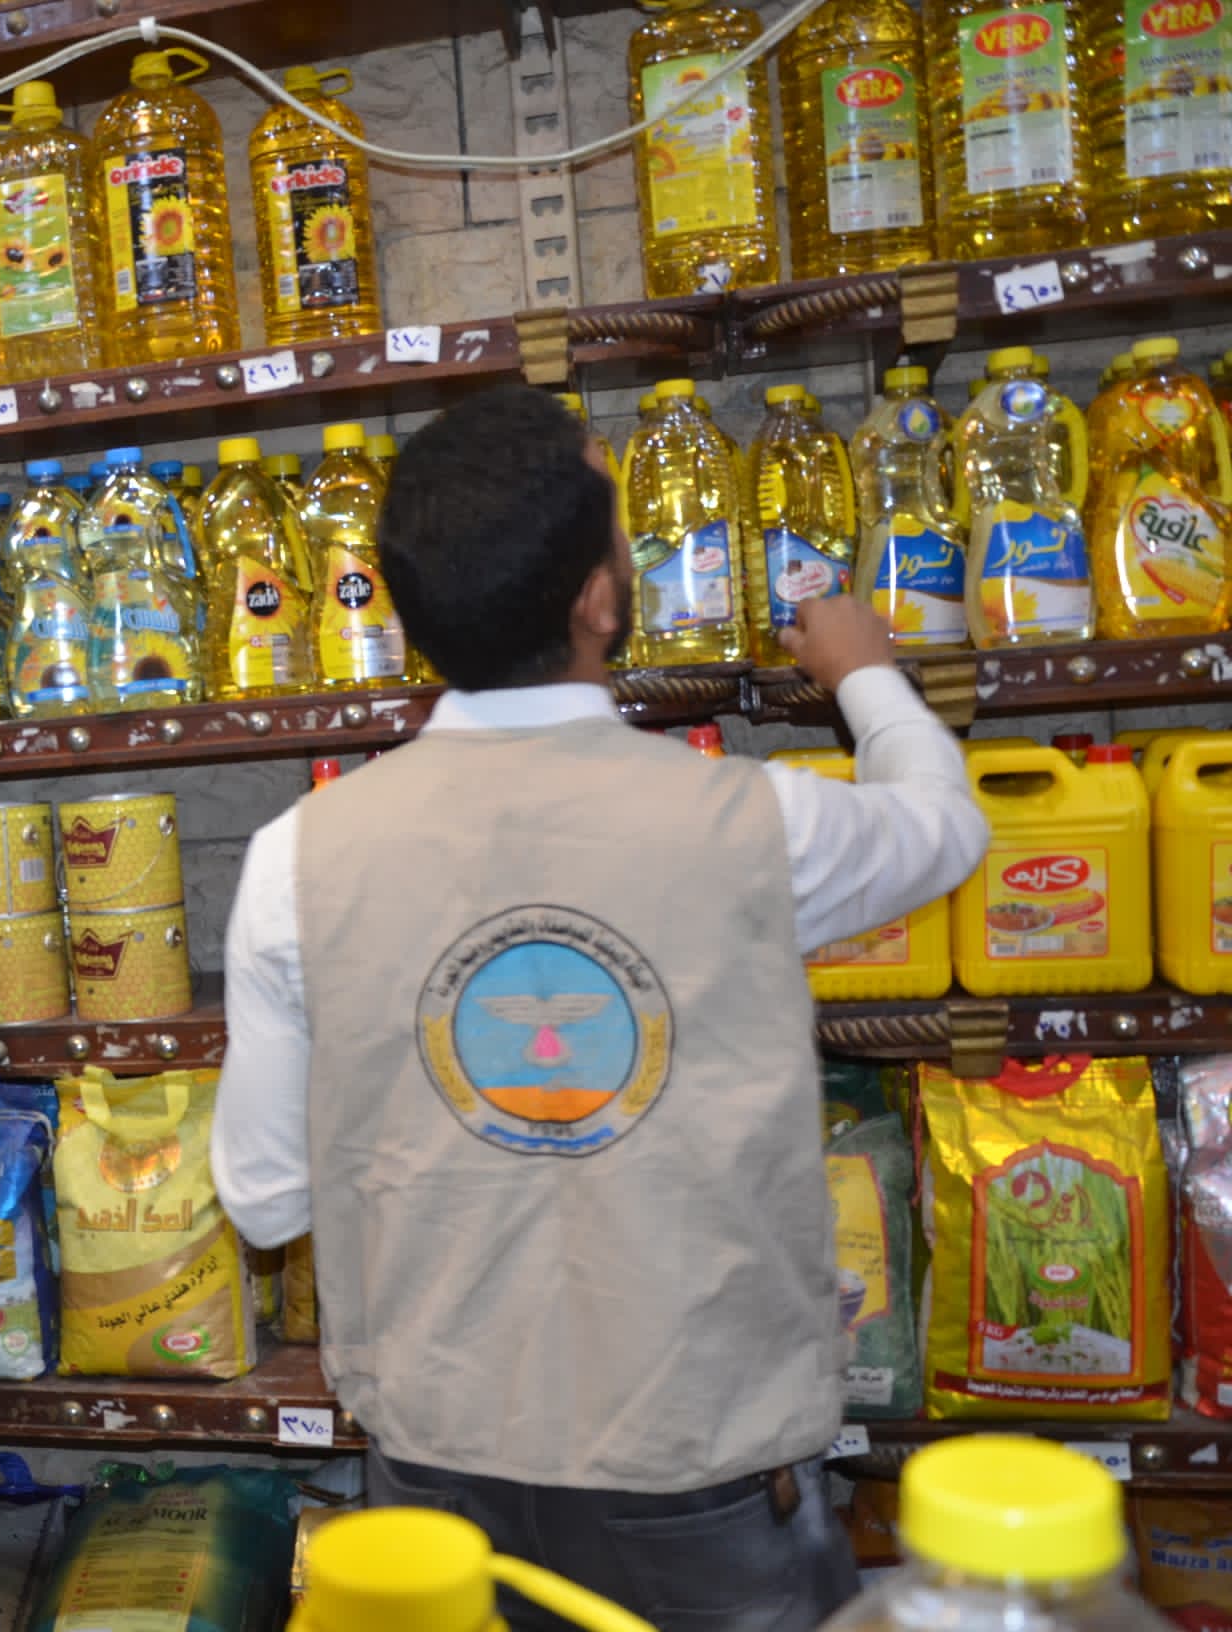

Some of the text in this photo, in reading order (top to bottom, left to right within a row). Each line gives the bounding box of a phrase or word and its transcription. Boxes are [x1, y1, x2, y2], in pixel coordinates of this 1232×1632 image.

[1147, 2, 1215, 32] VERA
[980, 21, 1045, 52] VERA
[841, 78, 898, 101] VERA
[110, 155, 184, 186] orkide
[271, 167, 345, 193] orkide
[1138, 503, 1211, 553] عافية
[879, 543, 955, 580] نور
[989, 527, 1067, 570] نور
[1007, 858, 1081, 890] كريم
